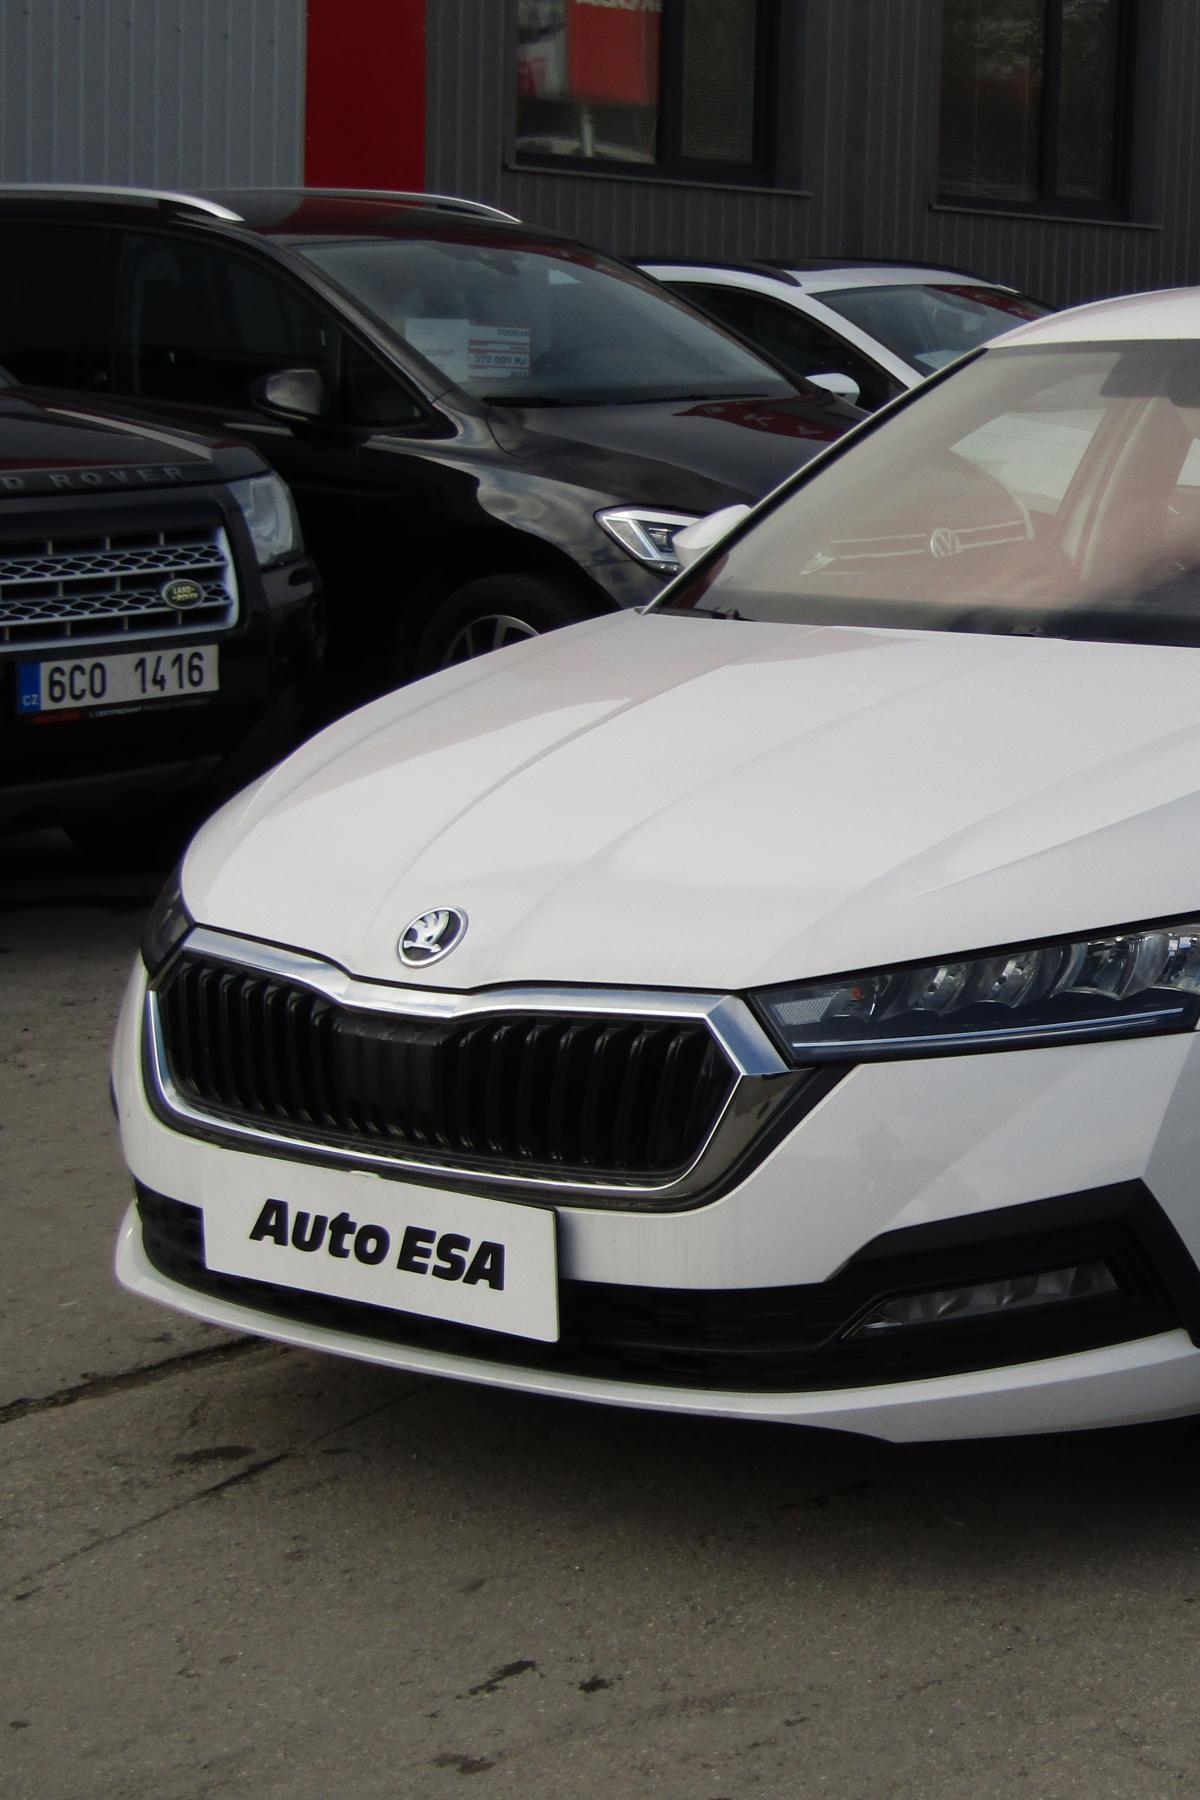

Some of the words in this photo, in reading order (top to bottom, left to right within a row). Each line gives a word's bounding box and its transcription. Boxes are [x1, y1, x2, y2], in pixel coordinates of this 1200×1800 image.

[50, 466, 184, 488] ROVER
[134, 651, 205, 694] 1416
[22, 693, 40, 706] CZ
[249, 1197, 391, 1266] Auto
[396, 1224, 506, 1291] ESA
